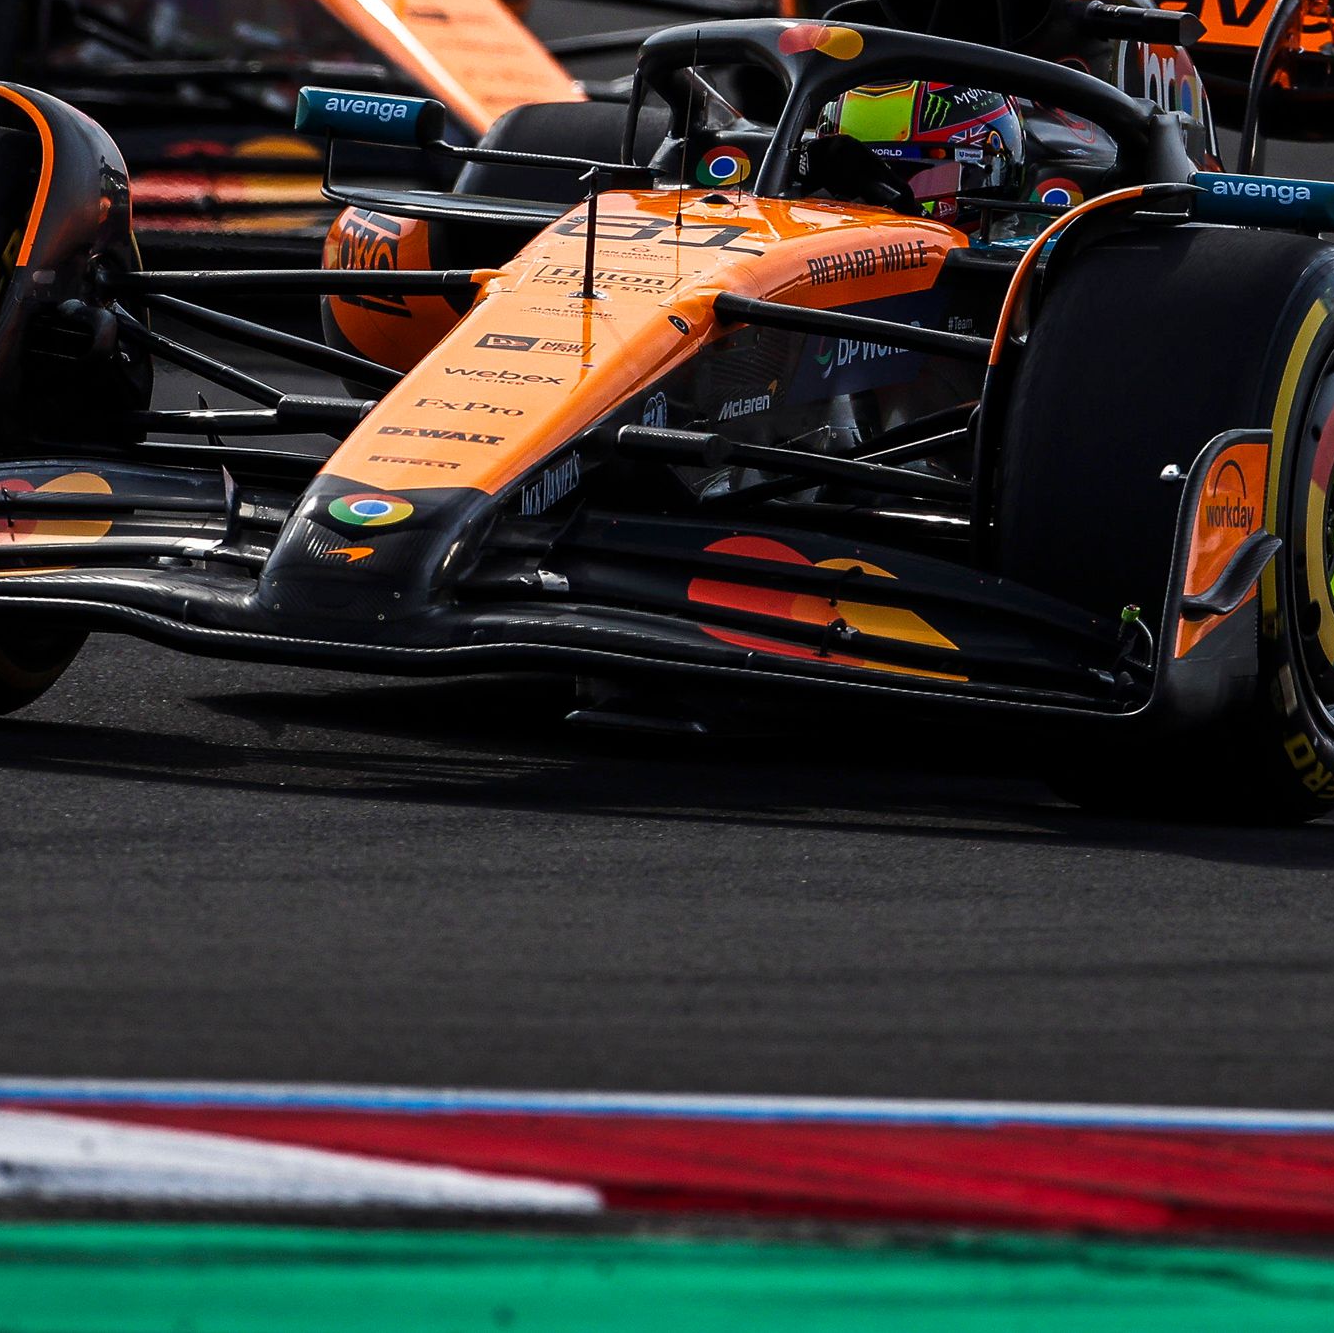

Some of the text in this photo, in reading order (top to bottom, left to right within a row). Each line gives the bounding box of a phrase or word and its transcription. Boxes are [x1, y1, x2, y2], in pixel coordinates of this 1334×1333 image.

[325, 97, 408, 123] avenga
[1212, 179, 1312, 205] avenga
[807, 239, 929, 287] RICHARD MILLE
[532, 278, 569, 286] FOR
[620, 286, 667, 295] STAY
[552, 267, 666, 286] Hlton
[445, 366, 565, 385] webex
[414, 398, 525, 416] FxPro
[717, 393, 770, 422] McLaren
[1205, 495, 1255, 536] workday
